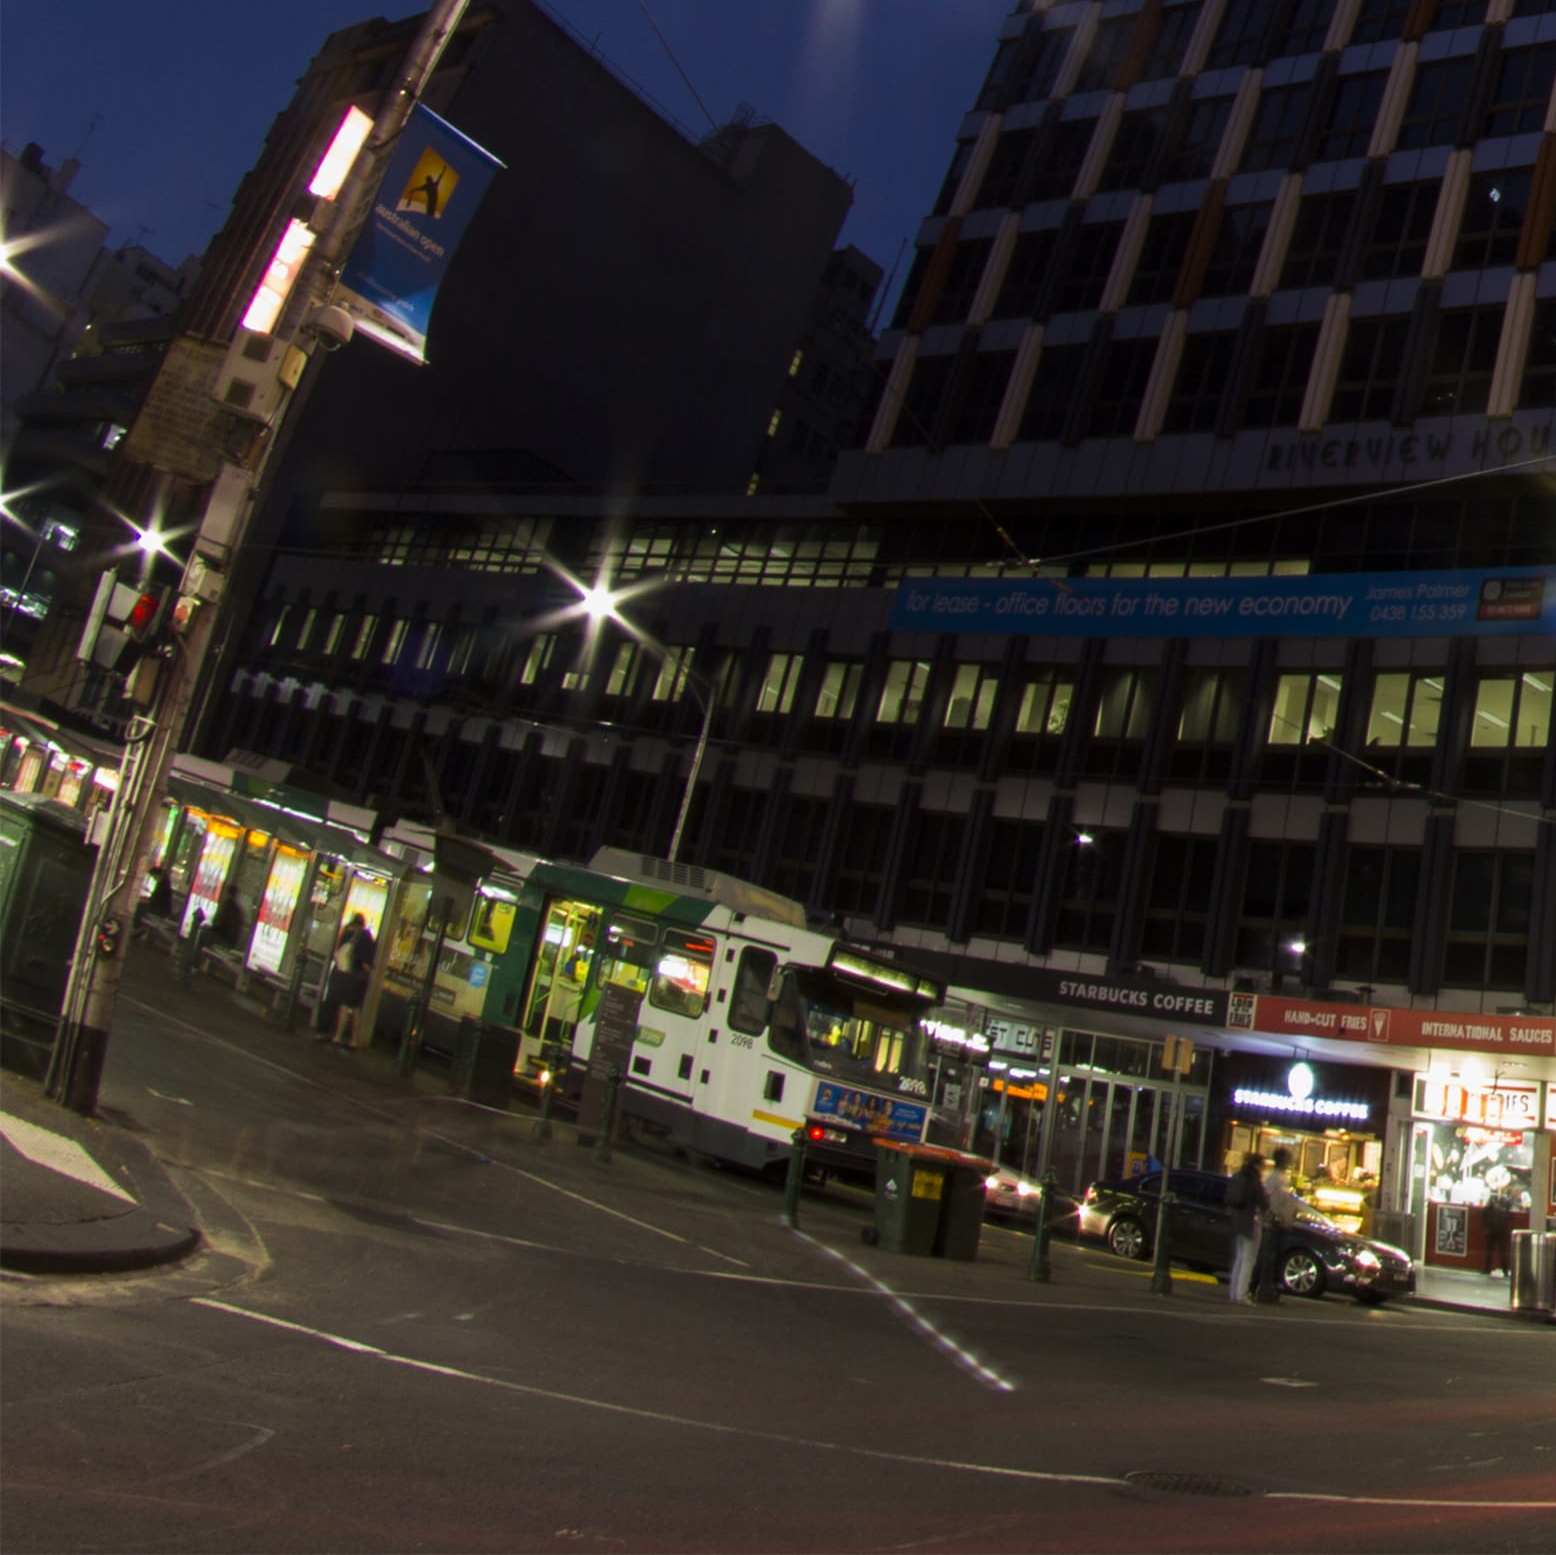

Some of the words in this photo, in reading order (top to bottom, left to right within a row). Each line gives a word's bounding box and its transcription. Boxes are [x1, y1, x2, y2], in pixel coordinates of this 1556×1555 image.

[420, 235, 444, 257] open
[1267, 432, 1455, 472] RIVERVIEW
[1365, 584, 1413, 601] James
[1416, 582, 1472, 599] Palmer
[905, 590, 928, 613] for
[932, 590, 979, 614] lease
[995, 591, 1050, 616] office
[1052, 590, 1107, 617] floors
[1110, 592, 1140, 617] for
[1143, 592, 1180, 617] the
[1183, 596, 1232, 618] new
[1238, 592, 1355, 623] economy
[1370, 604, 1406, 621] 0438
[1440, 603, 1467, 620] 359
[1058, 980, 1149, 1008] STARBUCKS
[1153, 993, 1214, 1015] COFFEE
[1284, 1009, 1336, 1028] HAND-CUT
[1341, 1013, 1368, 1031] FRIES
[730, 1033, 753, 1050] 2098
[1421, 1021, 1503, 1043] INTERNATIONAL
[1509, 1027, 1553, 1045] SAUCES
[1234, 1089, 1315, 1113] STARBUCKS
[1315, 1099, 1369, 1119] COFFEE
